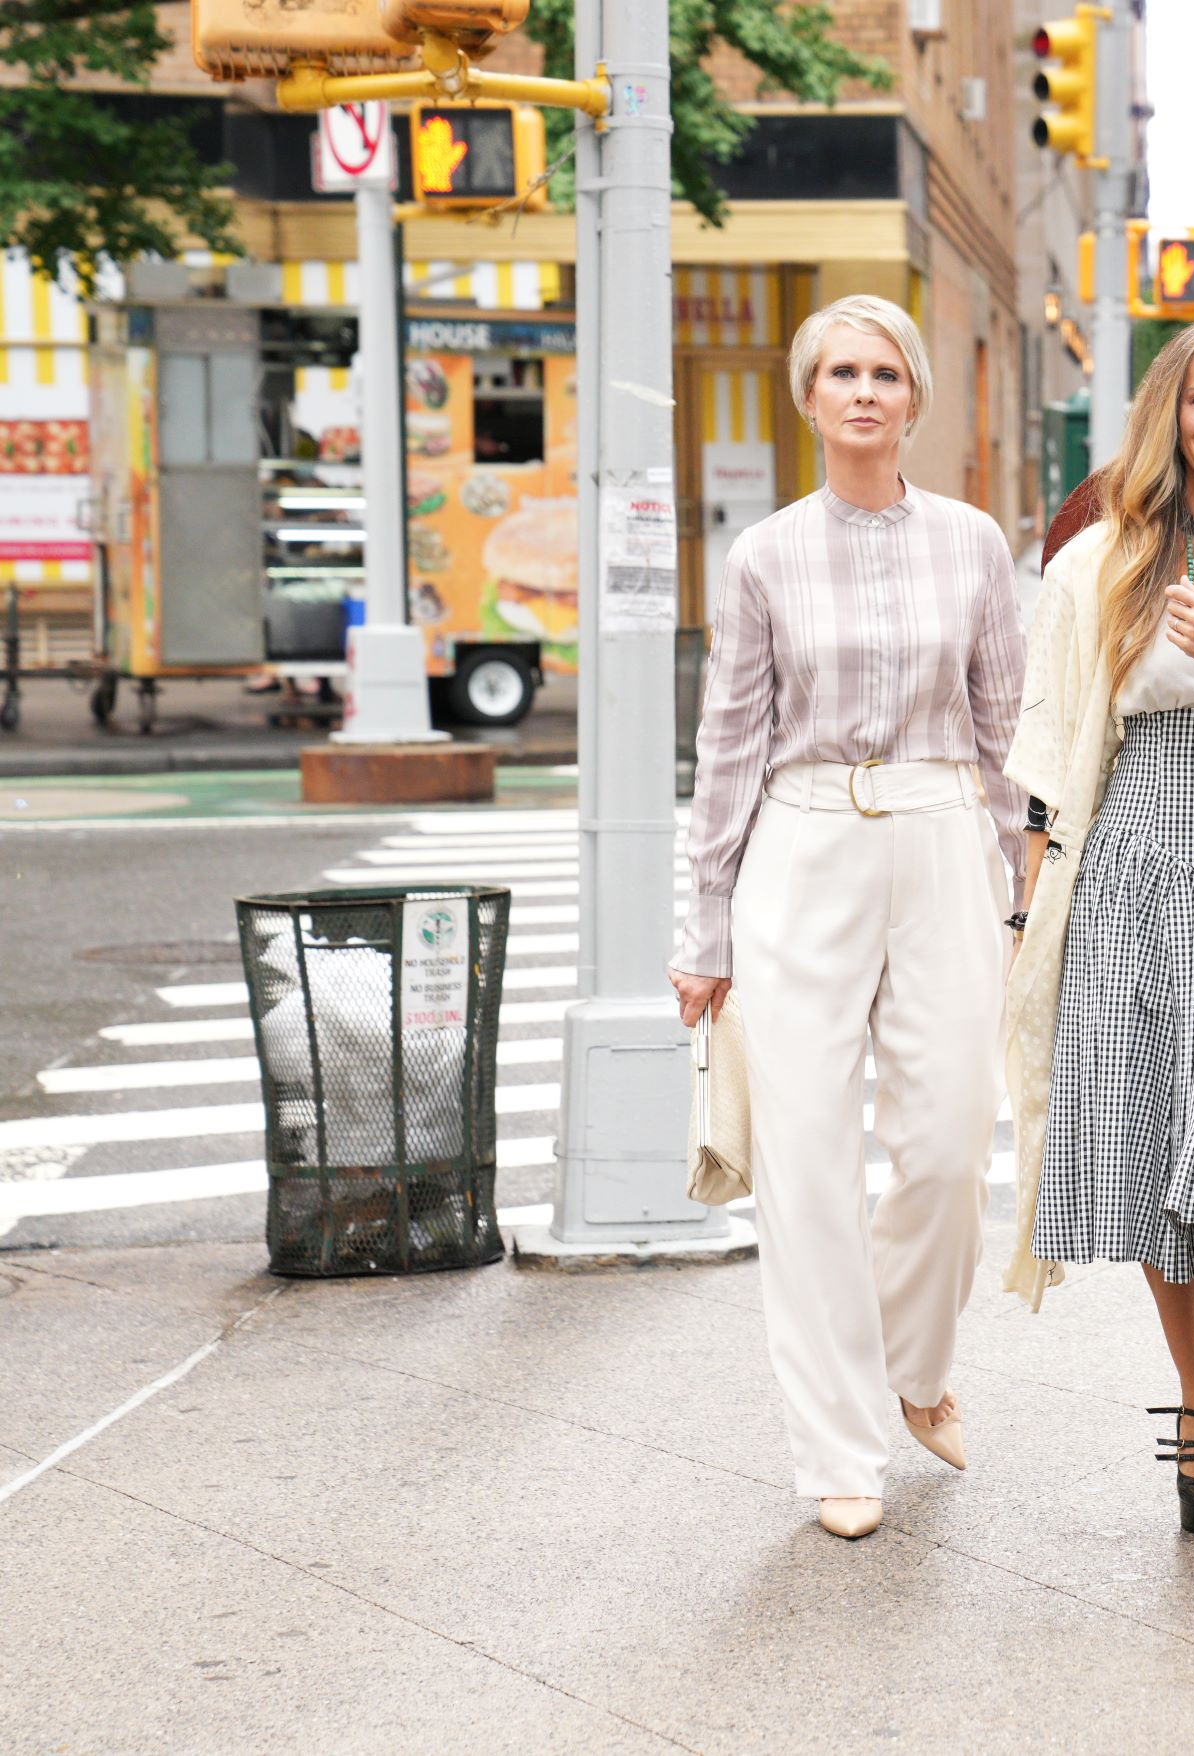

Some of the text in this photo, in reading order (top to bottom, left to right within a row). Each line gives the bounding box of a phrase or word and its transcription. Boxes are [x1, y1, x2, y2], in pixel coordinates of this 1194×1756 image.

[408, 321, 490, 350] HOUSE
[405, 958, 417, 967] NO
[410, 984, 422, 993] NO
